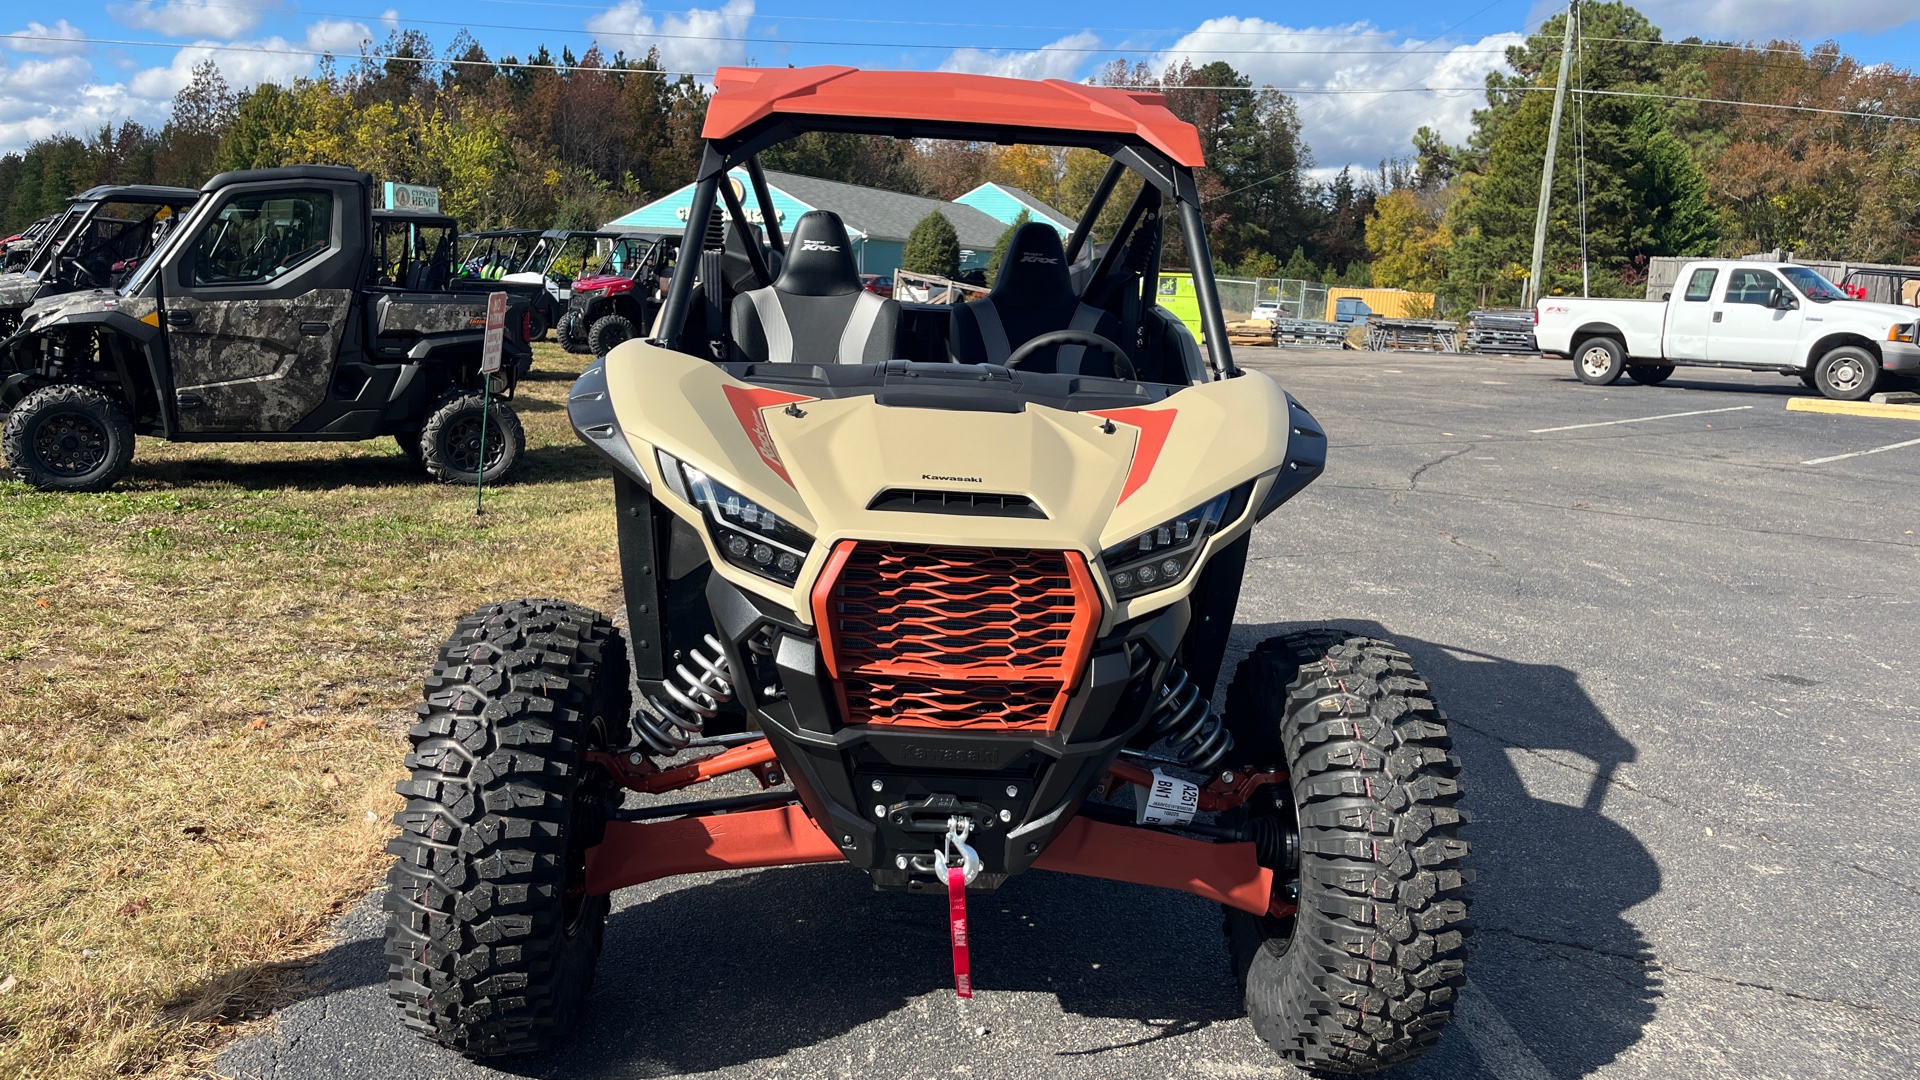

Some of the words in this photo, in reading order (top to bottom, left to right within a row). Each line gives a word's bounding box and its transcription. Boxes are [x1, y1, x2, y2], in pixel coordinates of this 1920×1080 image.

[411, 189, 437, 198] CYPRESS
[412, 197, 437, 207] HEMP
[800, 244, 841, 253] KRX
[1019, 256, 1059, 265] KRX
[921, 474, 983, 484] Kawasaki
[899, 743, 1000, 764] Kawasaki
[1154, 779, 1174, 799] BN1
[1181, 783, 1198, 808] A251
[953, 918, 967, 947] WARN
[957, 973, 971, 995] WARN
